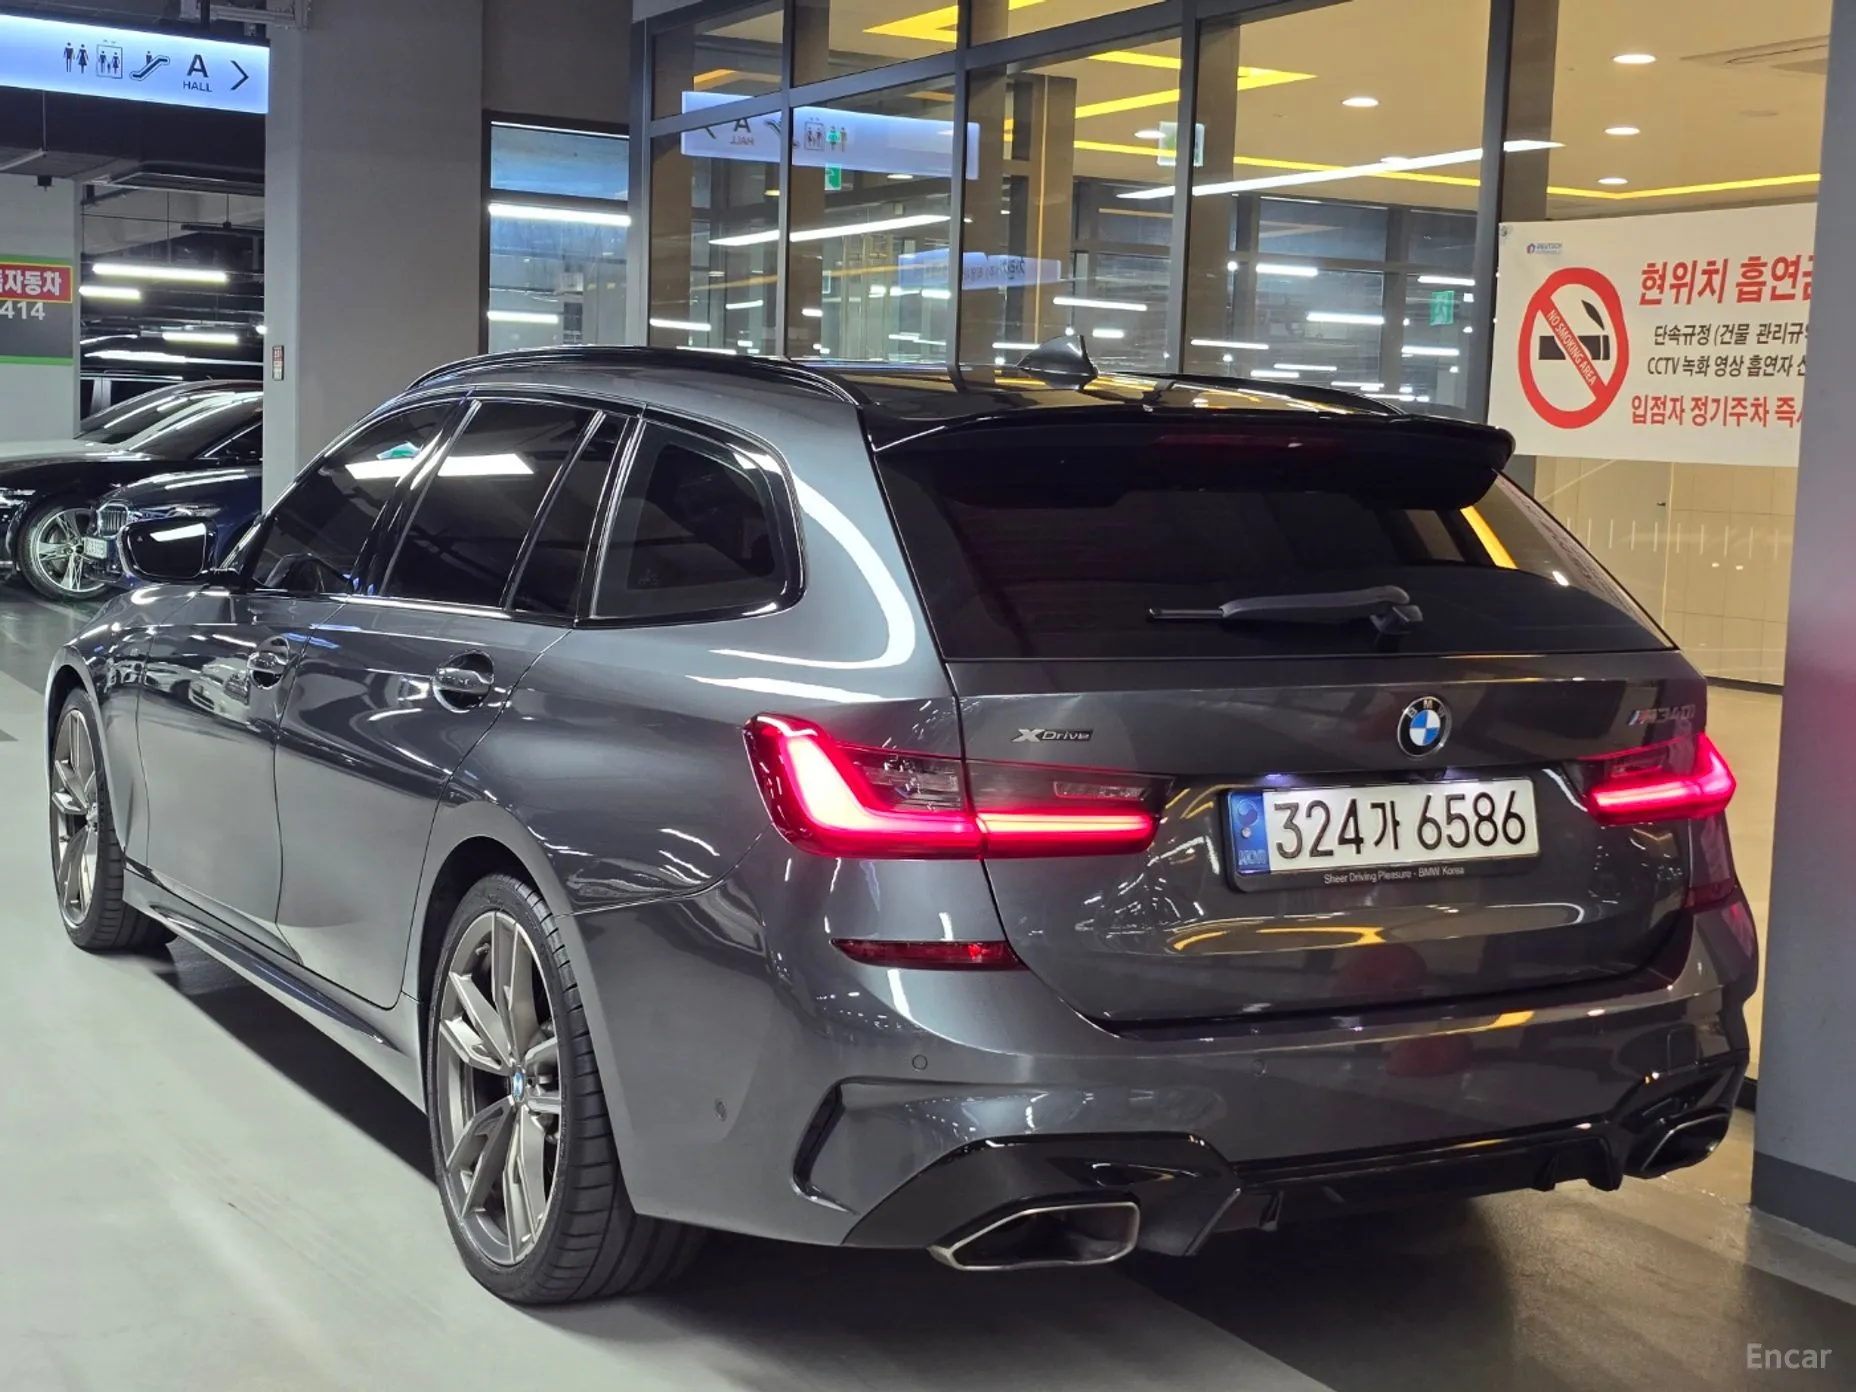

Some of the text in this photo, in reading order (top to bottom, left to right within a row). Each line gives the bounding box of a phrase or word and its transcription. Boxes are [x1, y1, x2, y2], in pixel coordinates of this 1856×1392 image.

[187, 54, 208, 78] A
[183, 80, 212, 92] HALL
[1639, 258, 1728, 306] 현위치
[1654, 323, 1711, 346] 단속규정
[1714, 322, 1750, 346] (건물
[1547, 309, 1597, 386] NO SMOKING AREA
[1647, 356, 1680, 375] CCTV
[1682, 355, 1710, 377] 녹화
[1714, 355, 1744, 378] 영상
[1747, 354, 1793, 377] 흡연자
[1631, 394, 1685, 426] 입점자
[1690, 395, 1770, 428] 정기주차
[1274, 790, 1526, 859] 324가 6586
[1324, 866, 1465, 884] Sheer Driving Pleasure BMW Korea
